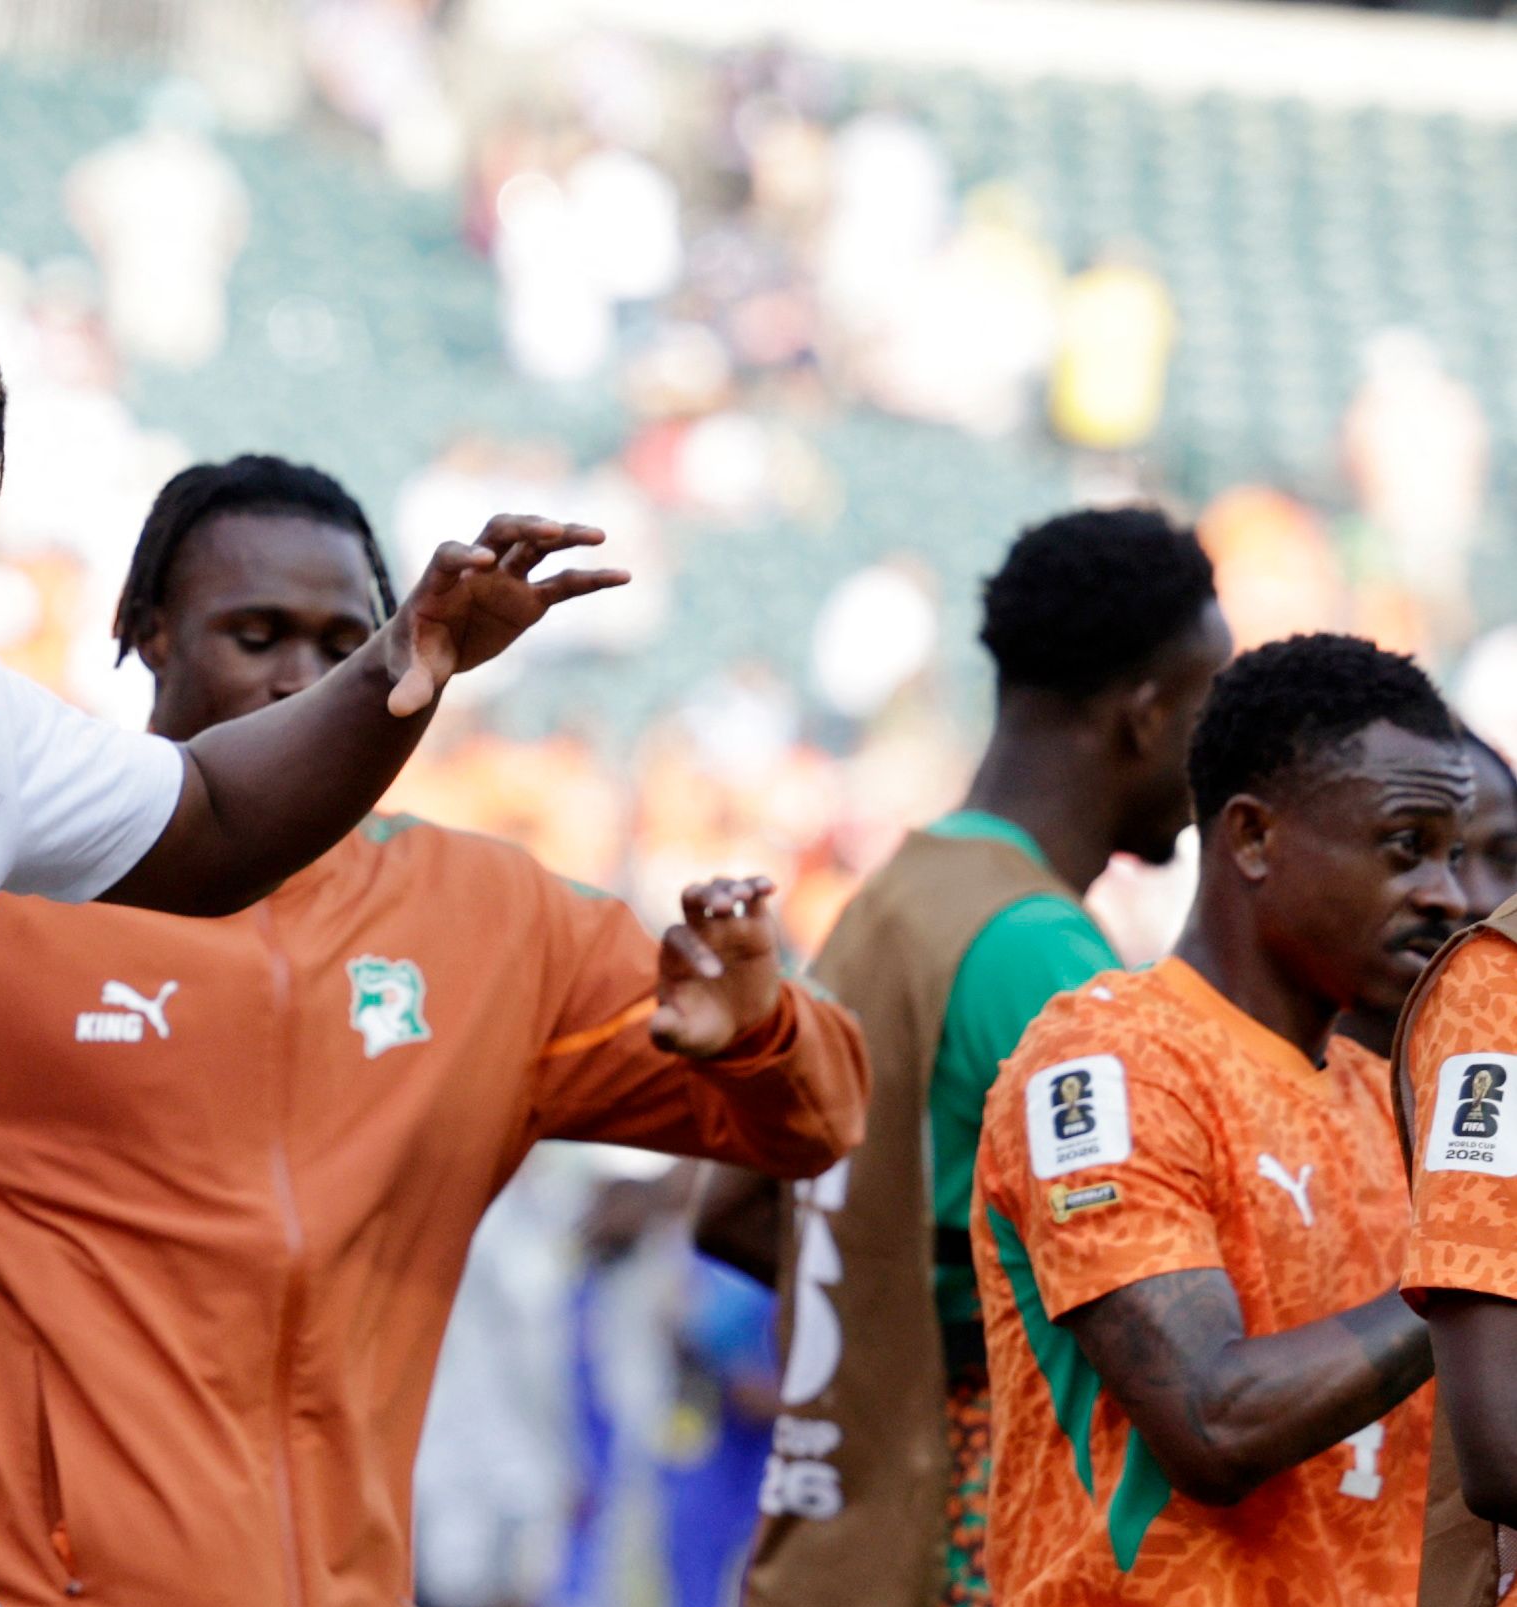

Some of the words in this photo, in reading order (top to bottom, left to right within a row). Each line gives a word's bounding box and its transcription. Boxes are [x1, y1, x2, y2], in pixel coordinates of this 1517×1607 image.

[75, 1012, 144, 1042] KING
[1461, 1121, 1486, 1132] FIFA
[1448, 1141, 1476, 1149] WORLD
[1478, 1142, 1496, 1150] CUP
[1445, 1149, 1494, 1163] 2026
